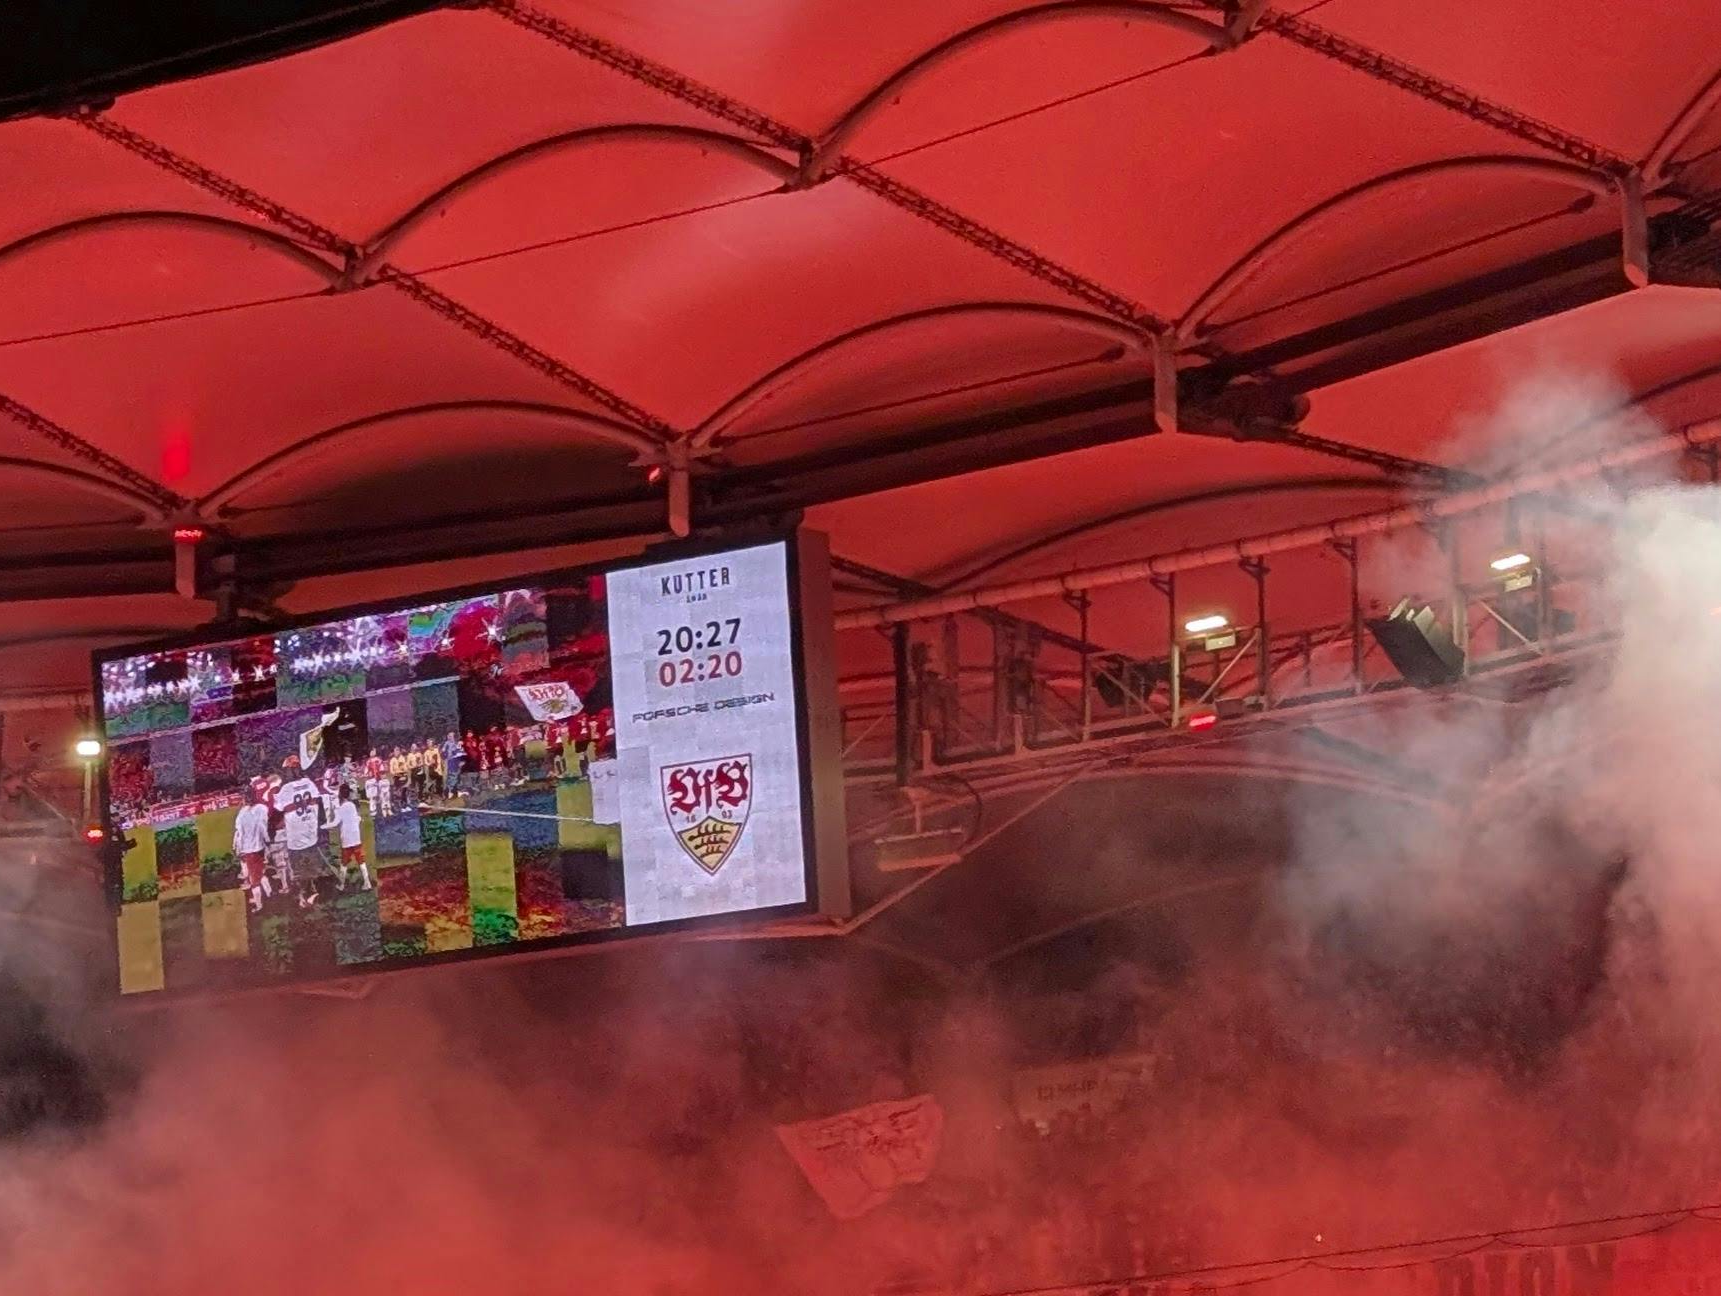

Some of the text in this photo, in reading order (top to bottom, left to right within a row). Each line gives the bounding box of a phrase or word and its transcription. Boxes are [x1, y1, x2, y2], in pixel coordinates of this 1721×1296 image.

[661, 566, 730, 596] KUTTER
[656, 617, 741, 656] 20:27
[658, 650, 742, 687] 02:20
[632, 691, 775, 723] PORSCHE DESIGN
[667, 760, 749, 815] VfB
